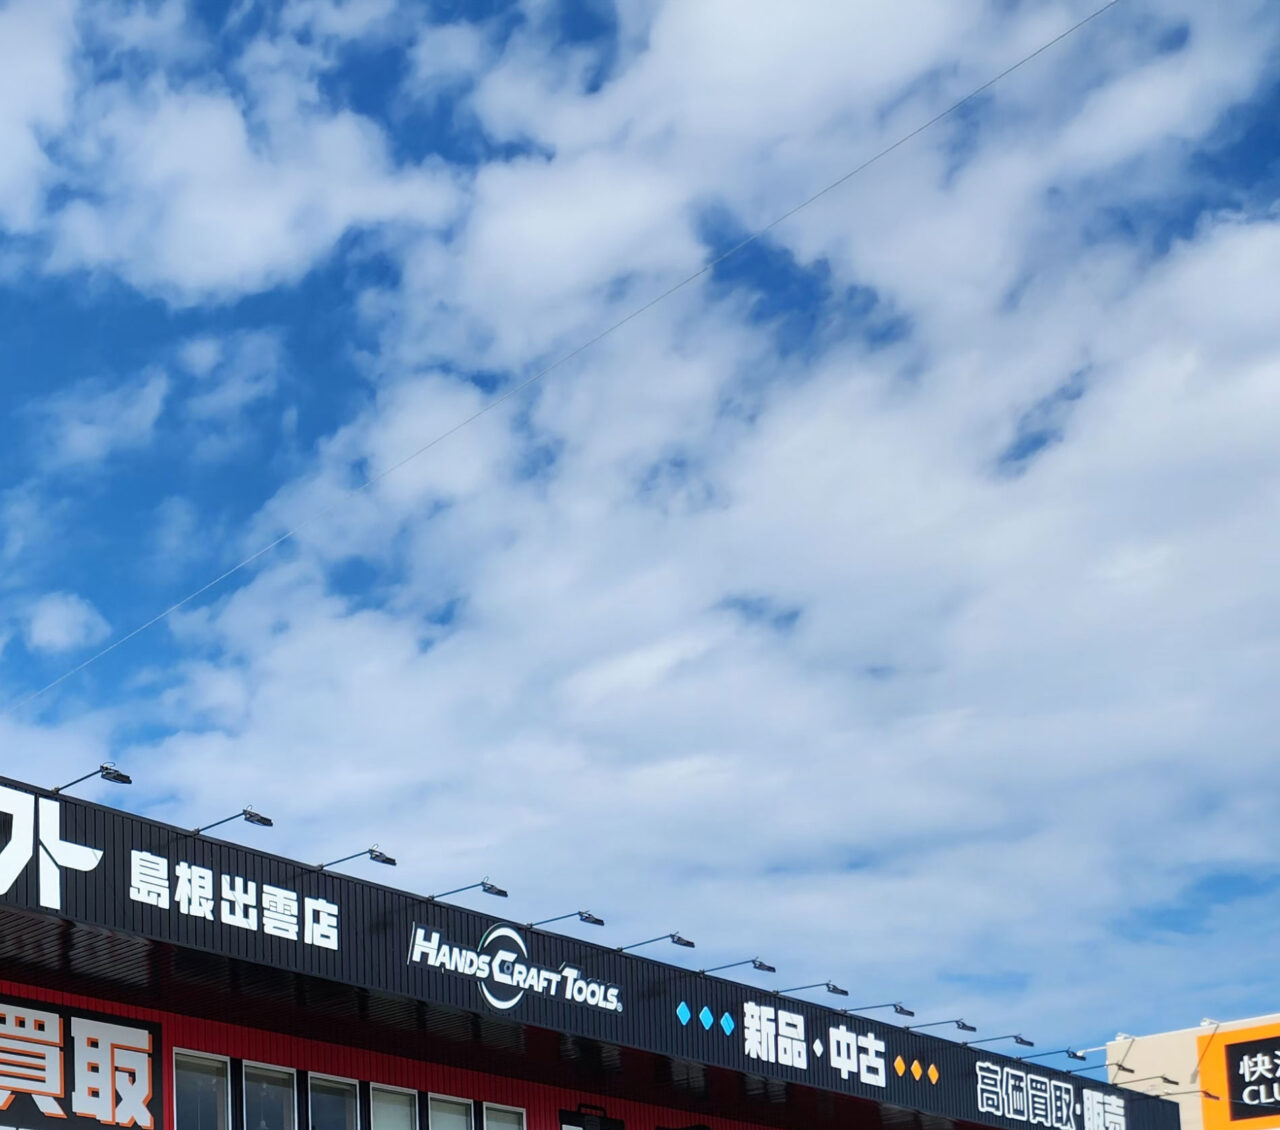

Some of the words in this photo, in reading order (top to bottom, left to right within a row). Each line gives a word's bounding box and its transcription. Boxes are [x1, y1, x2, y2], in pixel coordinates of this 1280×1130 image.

[129, 849, 339, 951] 島根出雲店
